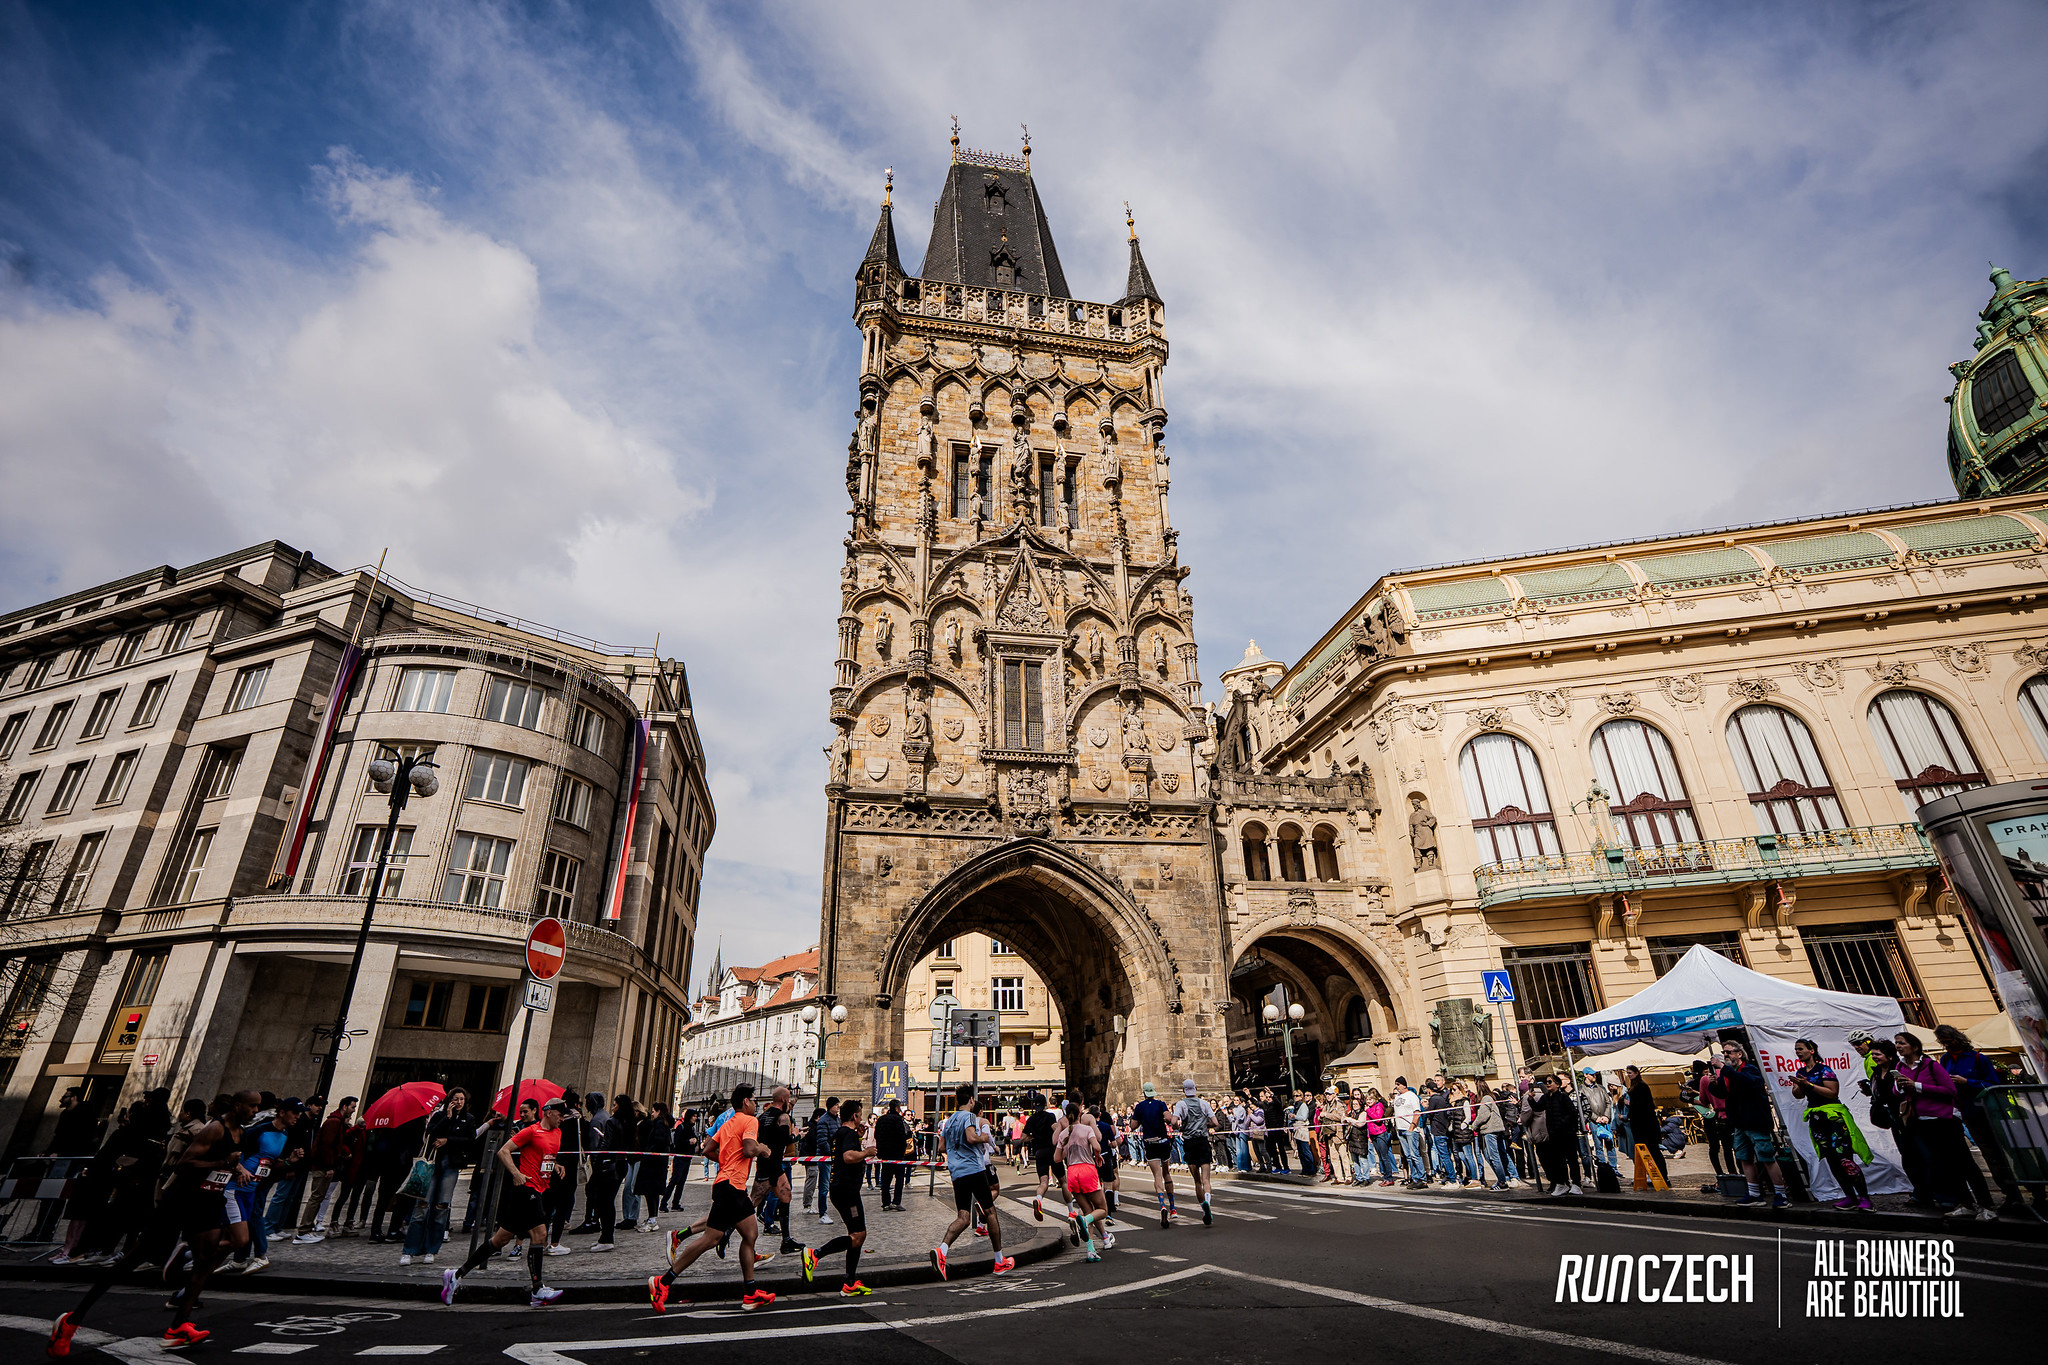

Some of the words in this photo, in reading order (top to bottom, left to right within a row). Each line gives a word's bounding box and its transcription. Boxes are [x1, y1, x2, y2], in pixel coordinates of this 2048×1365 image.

[1579, 1024, 1608, 1041] MUSIC
[1609, 1019, 1651, 1037] FESTIVAL
[1775, 1052, 1851, 1073] Radrnál
[879, 1065, 901, 1087] 14
[425, 1095, 440, 1108] 100
[374, 1117, 390, 1127] 100
